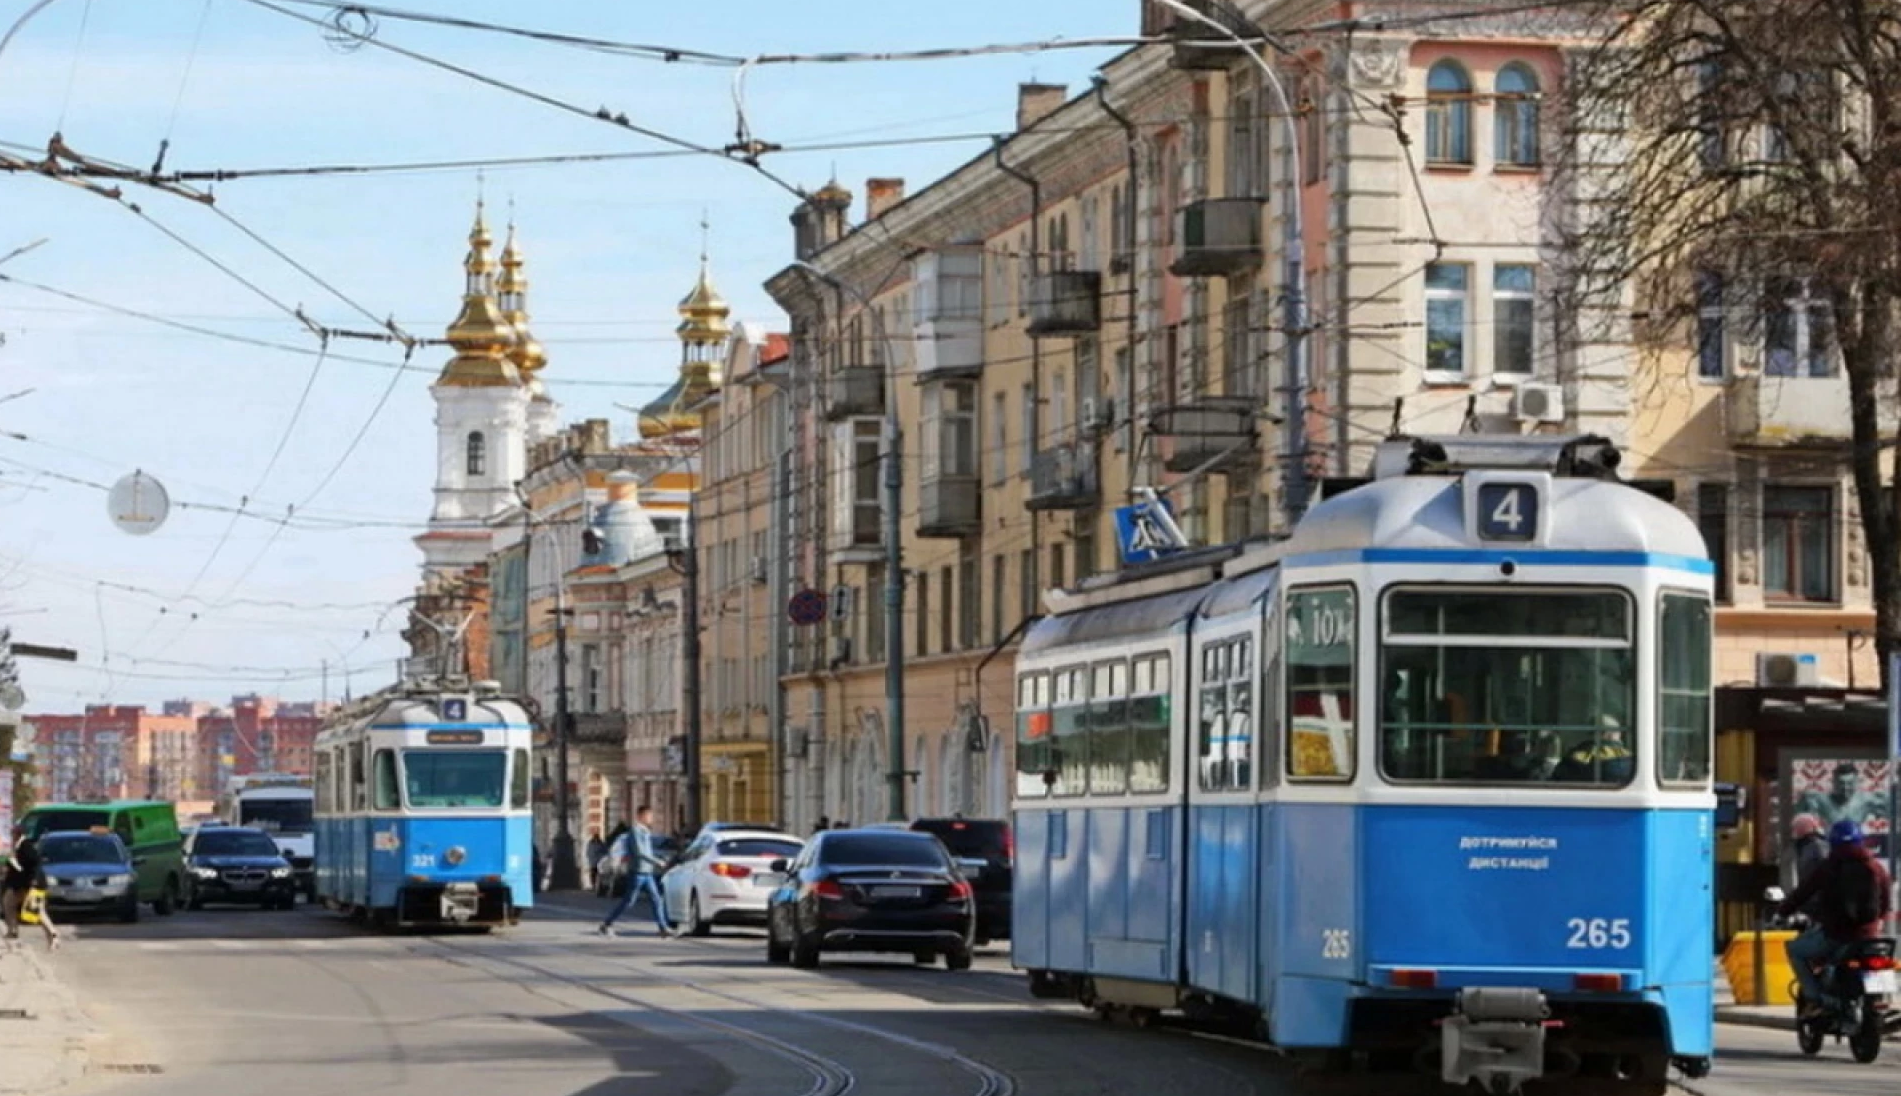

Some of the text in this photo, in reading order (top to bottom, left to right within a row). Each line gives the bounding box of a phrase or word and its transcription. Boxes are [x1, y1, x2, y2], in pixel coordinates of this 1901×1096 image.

[1492, 487, 1523, 532] 4
[448, 702, 462, 718] 4
[1322, 928, 1351, 959] 265
[1567, 918, 1631, 949] 265
